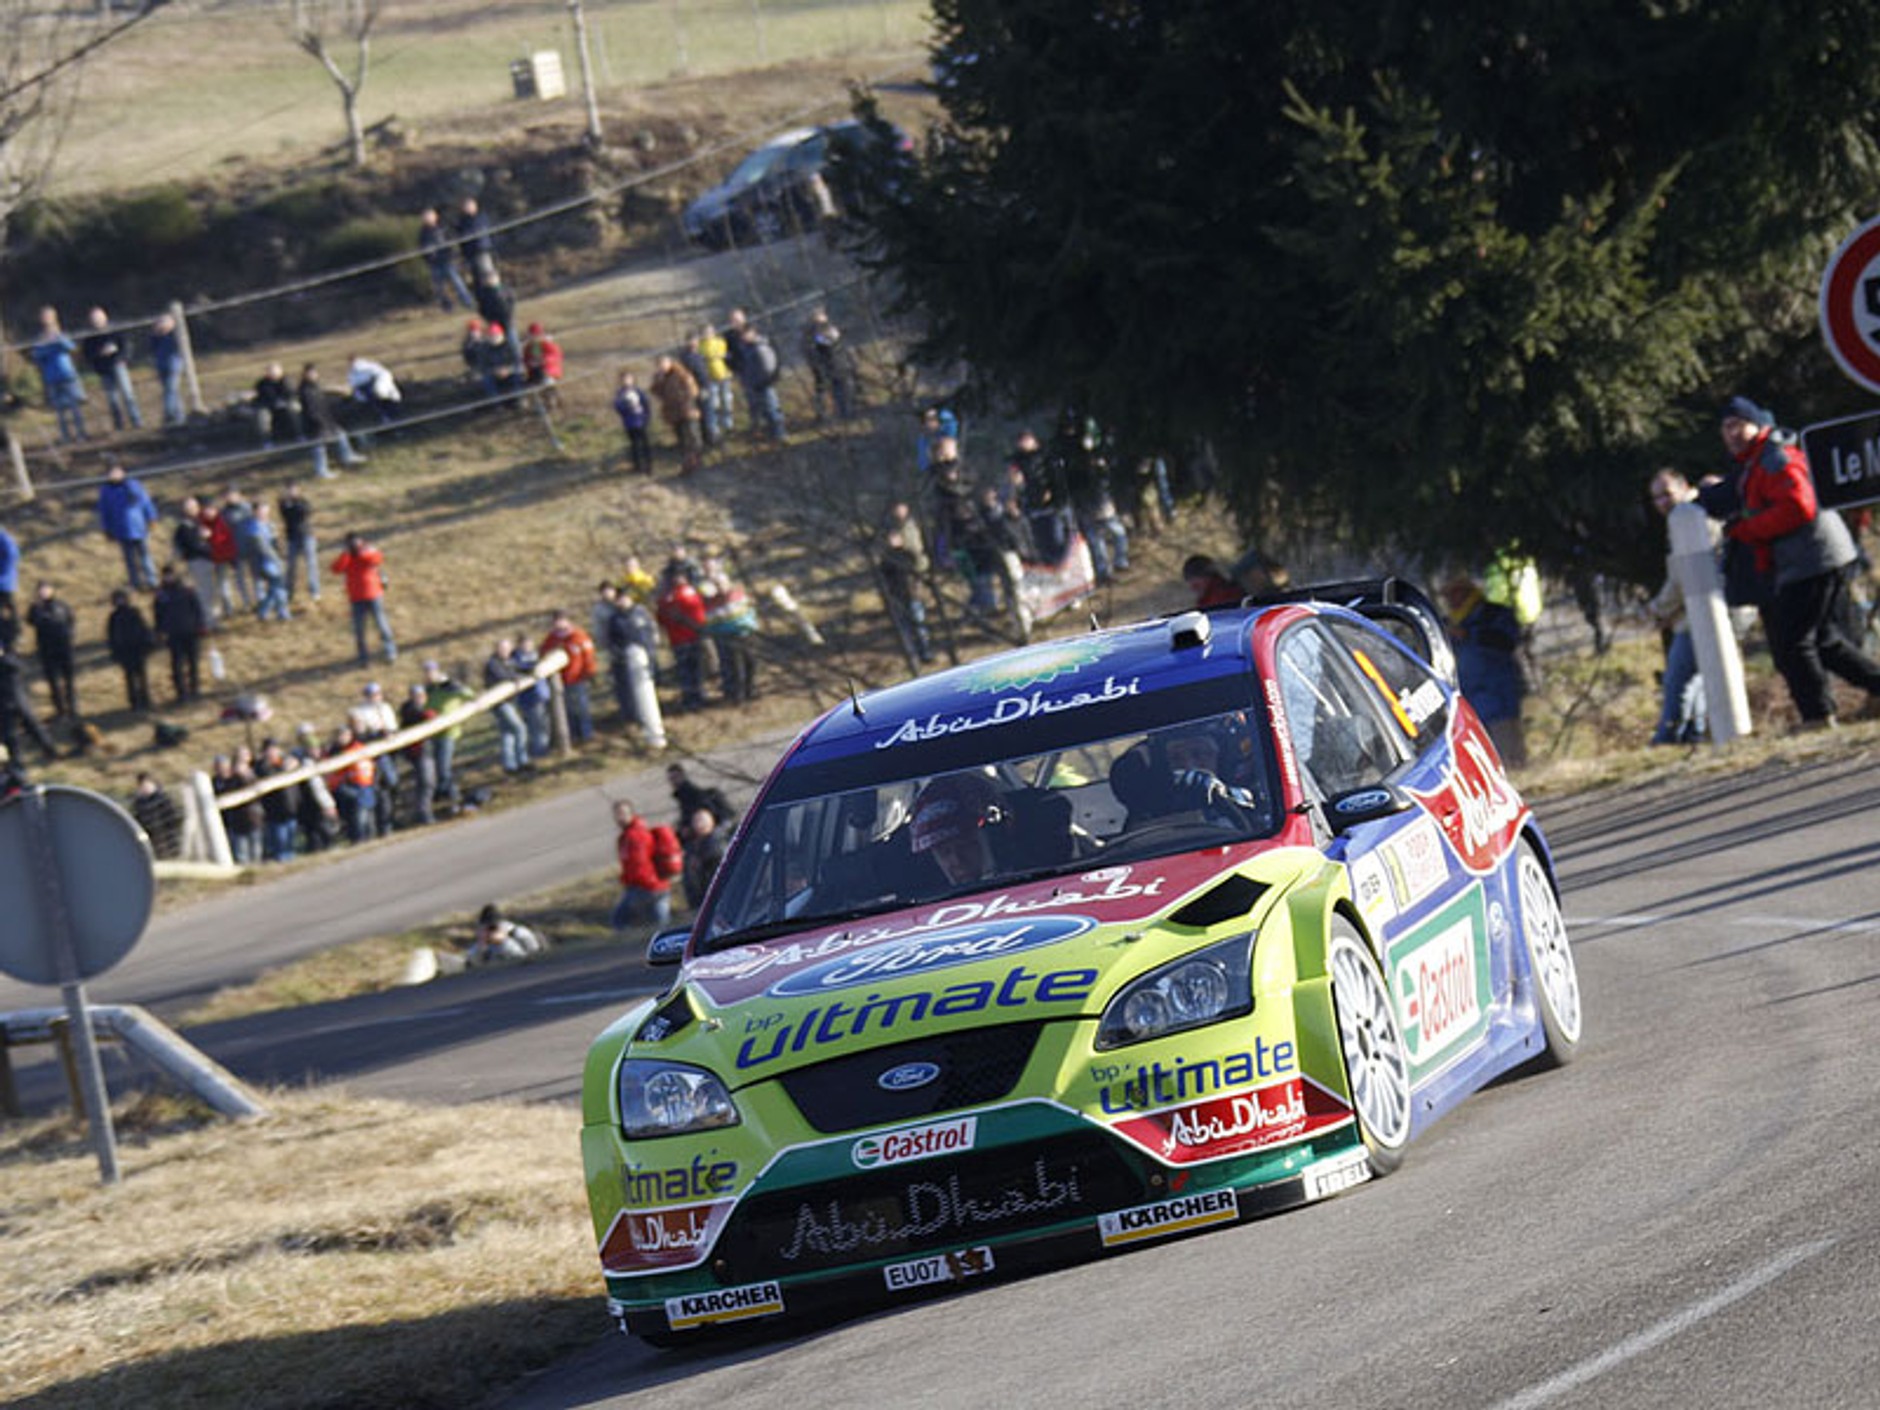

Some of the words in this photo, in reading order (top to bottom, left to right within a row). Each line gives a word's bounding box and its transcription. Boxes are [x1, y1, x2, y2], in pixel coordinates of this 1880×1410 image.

[1831, 446, 1862, 485] Le
[875, 712, 978, 749] Abu
[994, 676, 1141, 722] Dhabi
[822, 924, 1034, 985] Ford
[1420, 934, 1474, 1042] Castrol
[736, 966, 1099, 1069] ultimate
[745, 1013, 784, 1033] bp
[1091, 1065, 1121, 1083] bp
[1101, 1035, 1295, 1115] ultimate
[884, 1121, 967, 1161] Castrol
[1163, 1110, 1229, 1156] Abu
[1231, 1083, 1307, 1138] Dhabi
[781, 1201, 888, 1260] Abu
[892, 1157, 1082, 1238] Dhabi
[888, 1259, 940, 1287] EU07
